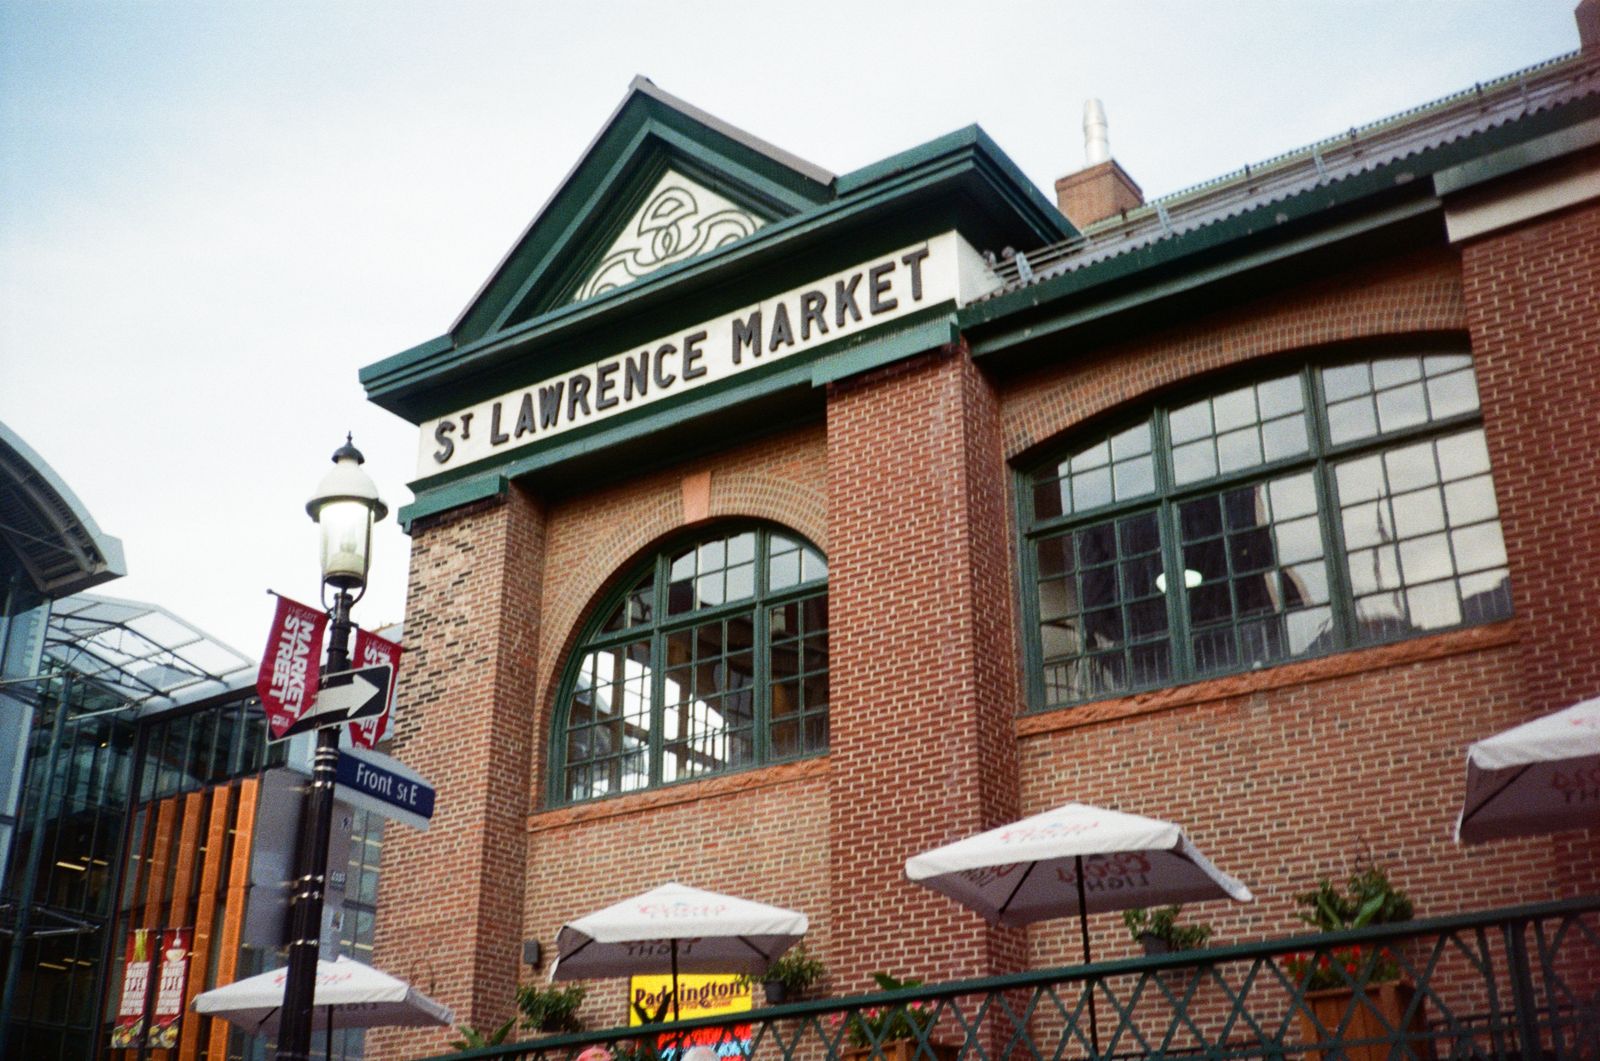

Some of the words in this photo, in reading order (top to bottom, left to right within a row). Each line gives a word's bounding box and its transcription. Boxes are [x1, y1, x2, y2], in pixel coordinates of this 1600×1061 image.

[489, 329, 709, 447] LAWRENCE
[731, 247, 930, 365] MARKET
[269, 614, 300, 704] STREET
[283, 620, 315, 719] MARKET
[356, 763, 393, 796] Front
[396, 783, 408, 803] St
[409, 784, 419, 806] E
